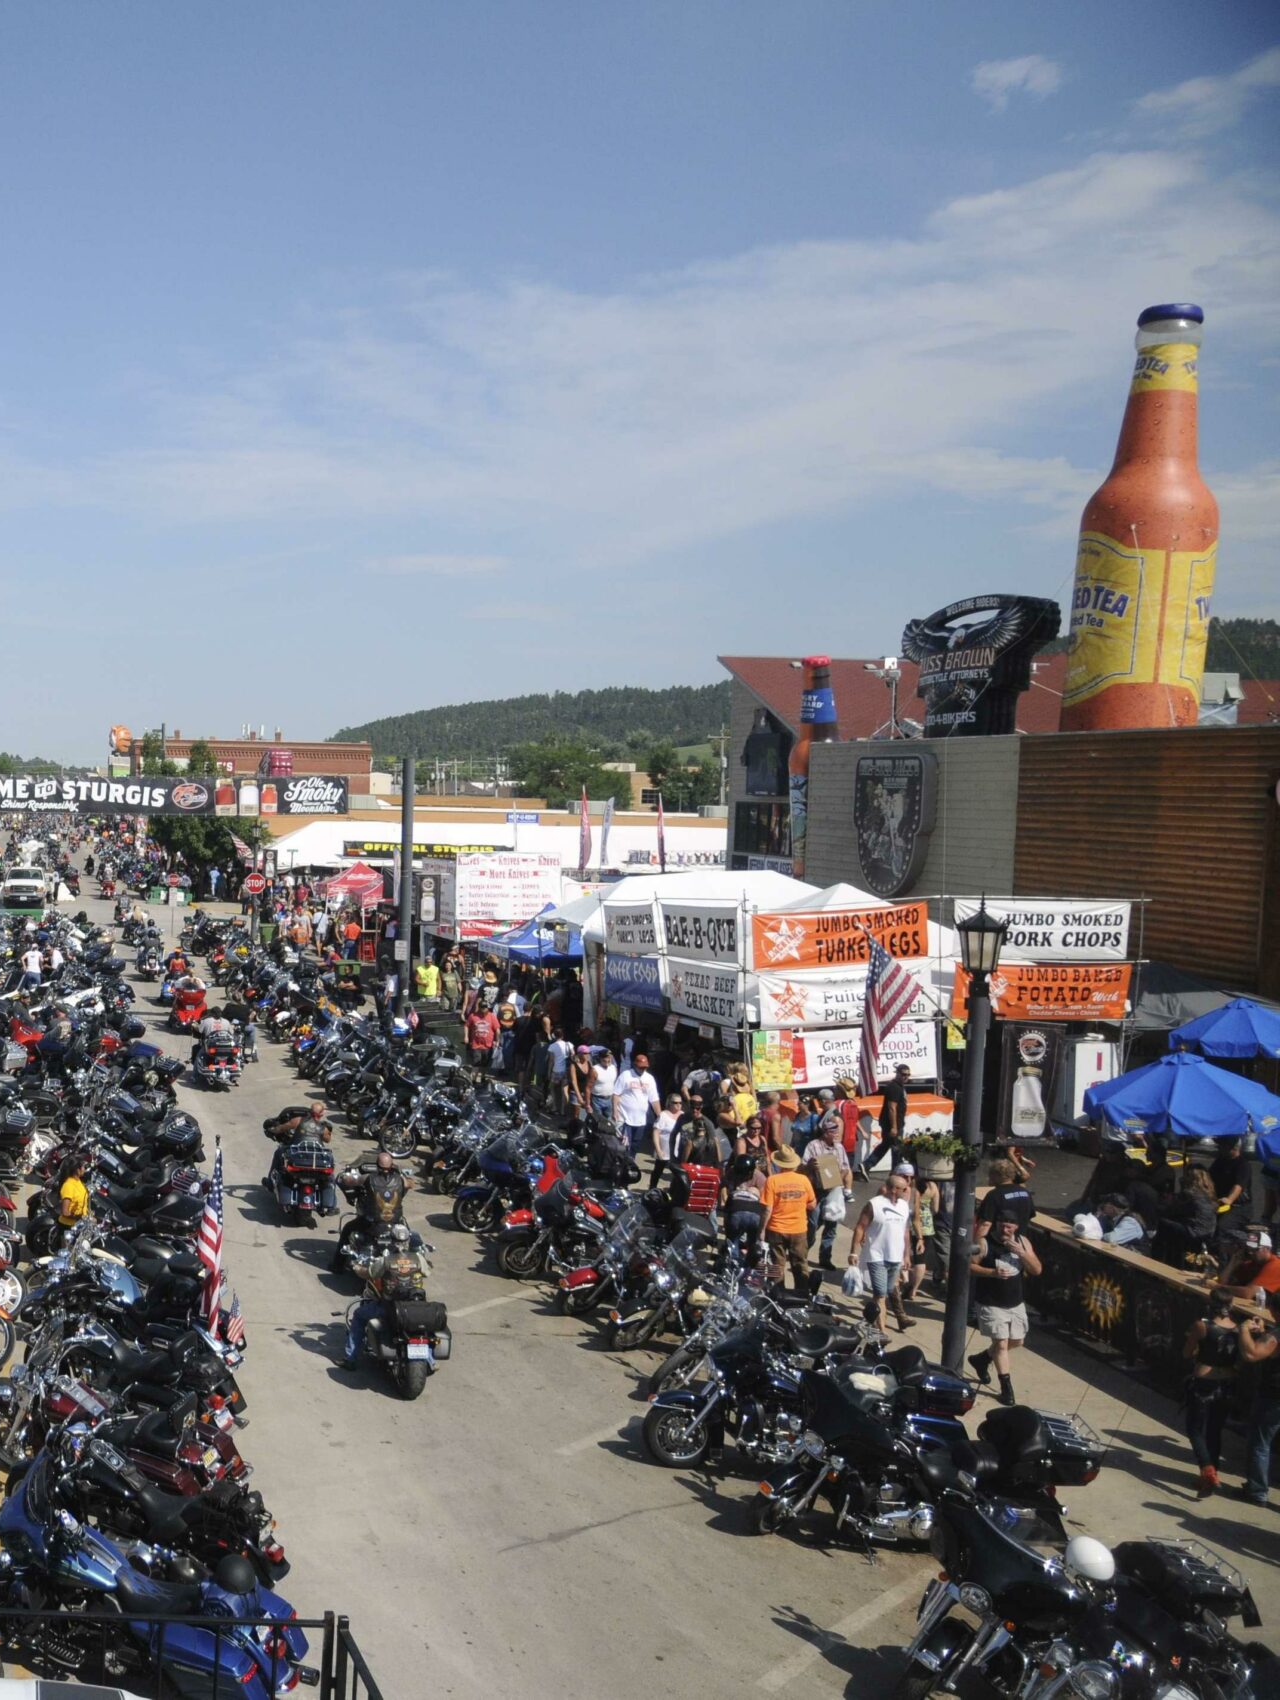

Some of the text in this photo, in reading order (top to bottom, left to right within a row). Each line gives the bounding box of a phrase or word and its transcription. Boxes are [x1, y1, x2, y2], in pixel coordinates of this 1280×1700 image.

[946, 598, 975, 616] WELCOME
[1092, 585, 1130, 618] TEA
[1085, 614, 1105, 629] Tea
[944, 648, 995, 668] BROWN
[949, 668, 989, 681] ATTORNEYS
[283, 778, 344, 803] Smoky
[307, 776, 324, 789] Ole
[61, 780, 166, 808] STURGIS
[0, 800, 28, 810] Shine
[363, 842, 495, 853] OFFIAL STURGIS
[498, 854, 520, 866] Knives
[489, 869, 530, 879] More Knives
[246, 879, 264, 888] STOP
[815, 908, 920, 934] JUMBO SMOKED
[1004, 912, 1124, 927] JUMBO SMOKED
[664, 914, 736, 957] BAR-B-QUE
[1003, 930, 1122, 948] PORK CHOPS
[815, 935, 871, 963] TURKE
[607, 959, 658, 984] GREEK FOOD
[1017, 967, 1122, 983] JUMBO BAKED
[684, 971, 736, 994] TEXAS BEEF
[1016, 986, 1120, 1002] POTATO With
[684, 991, 735, 1018] BRISKET
[824, 1008, 848, 1021] Pig
[823, 1038, 853, 1052] Giant
[882, 1040, 913, 1051] FOOD
[816, 1054, 852, 1067] Texas
